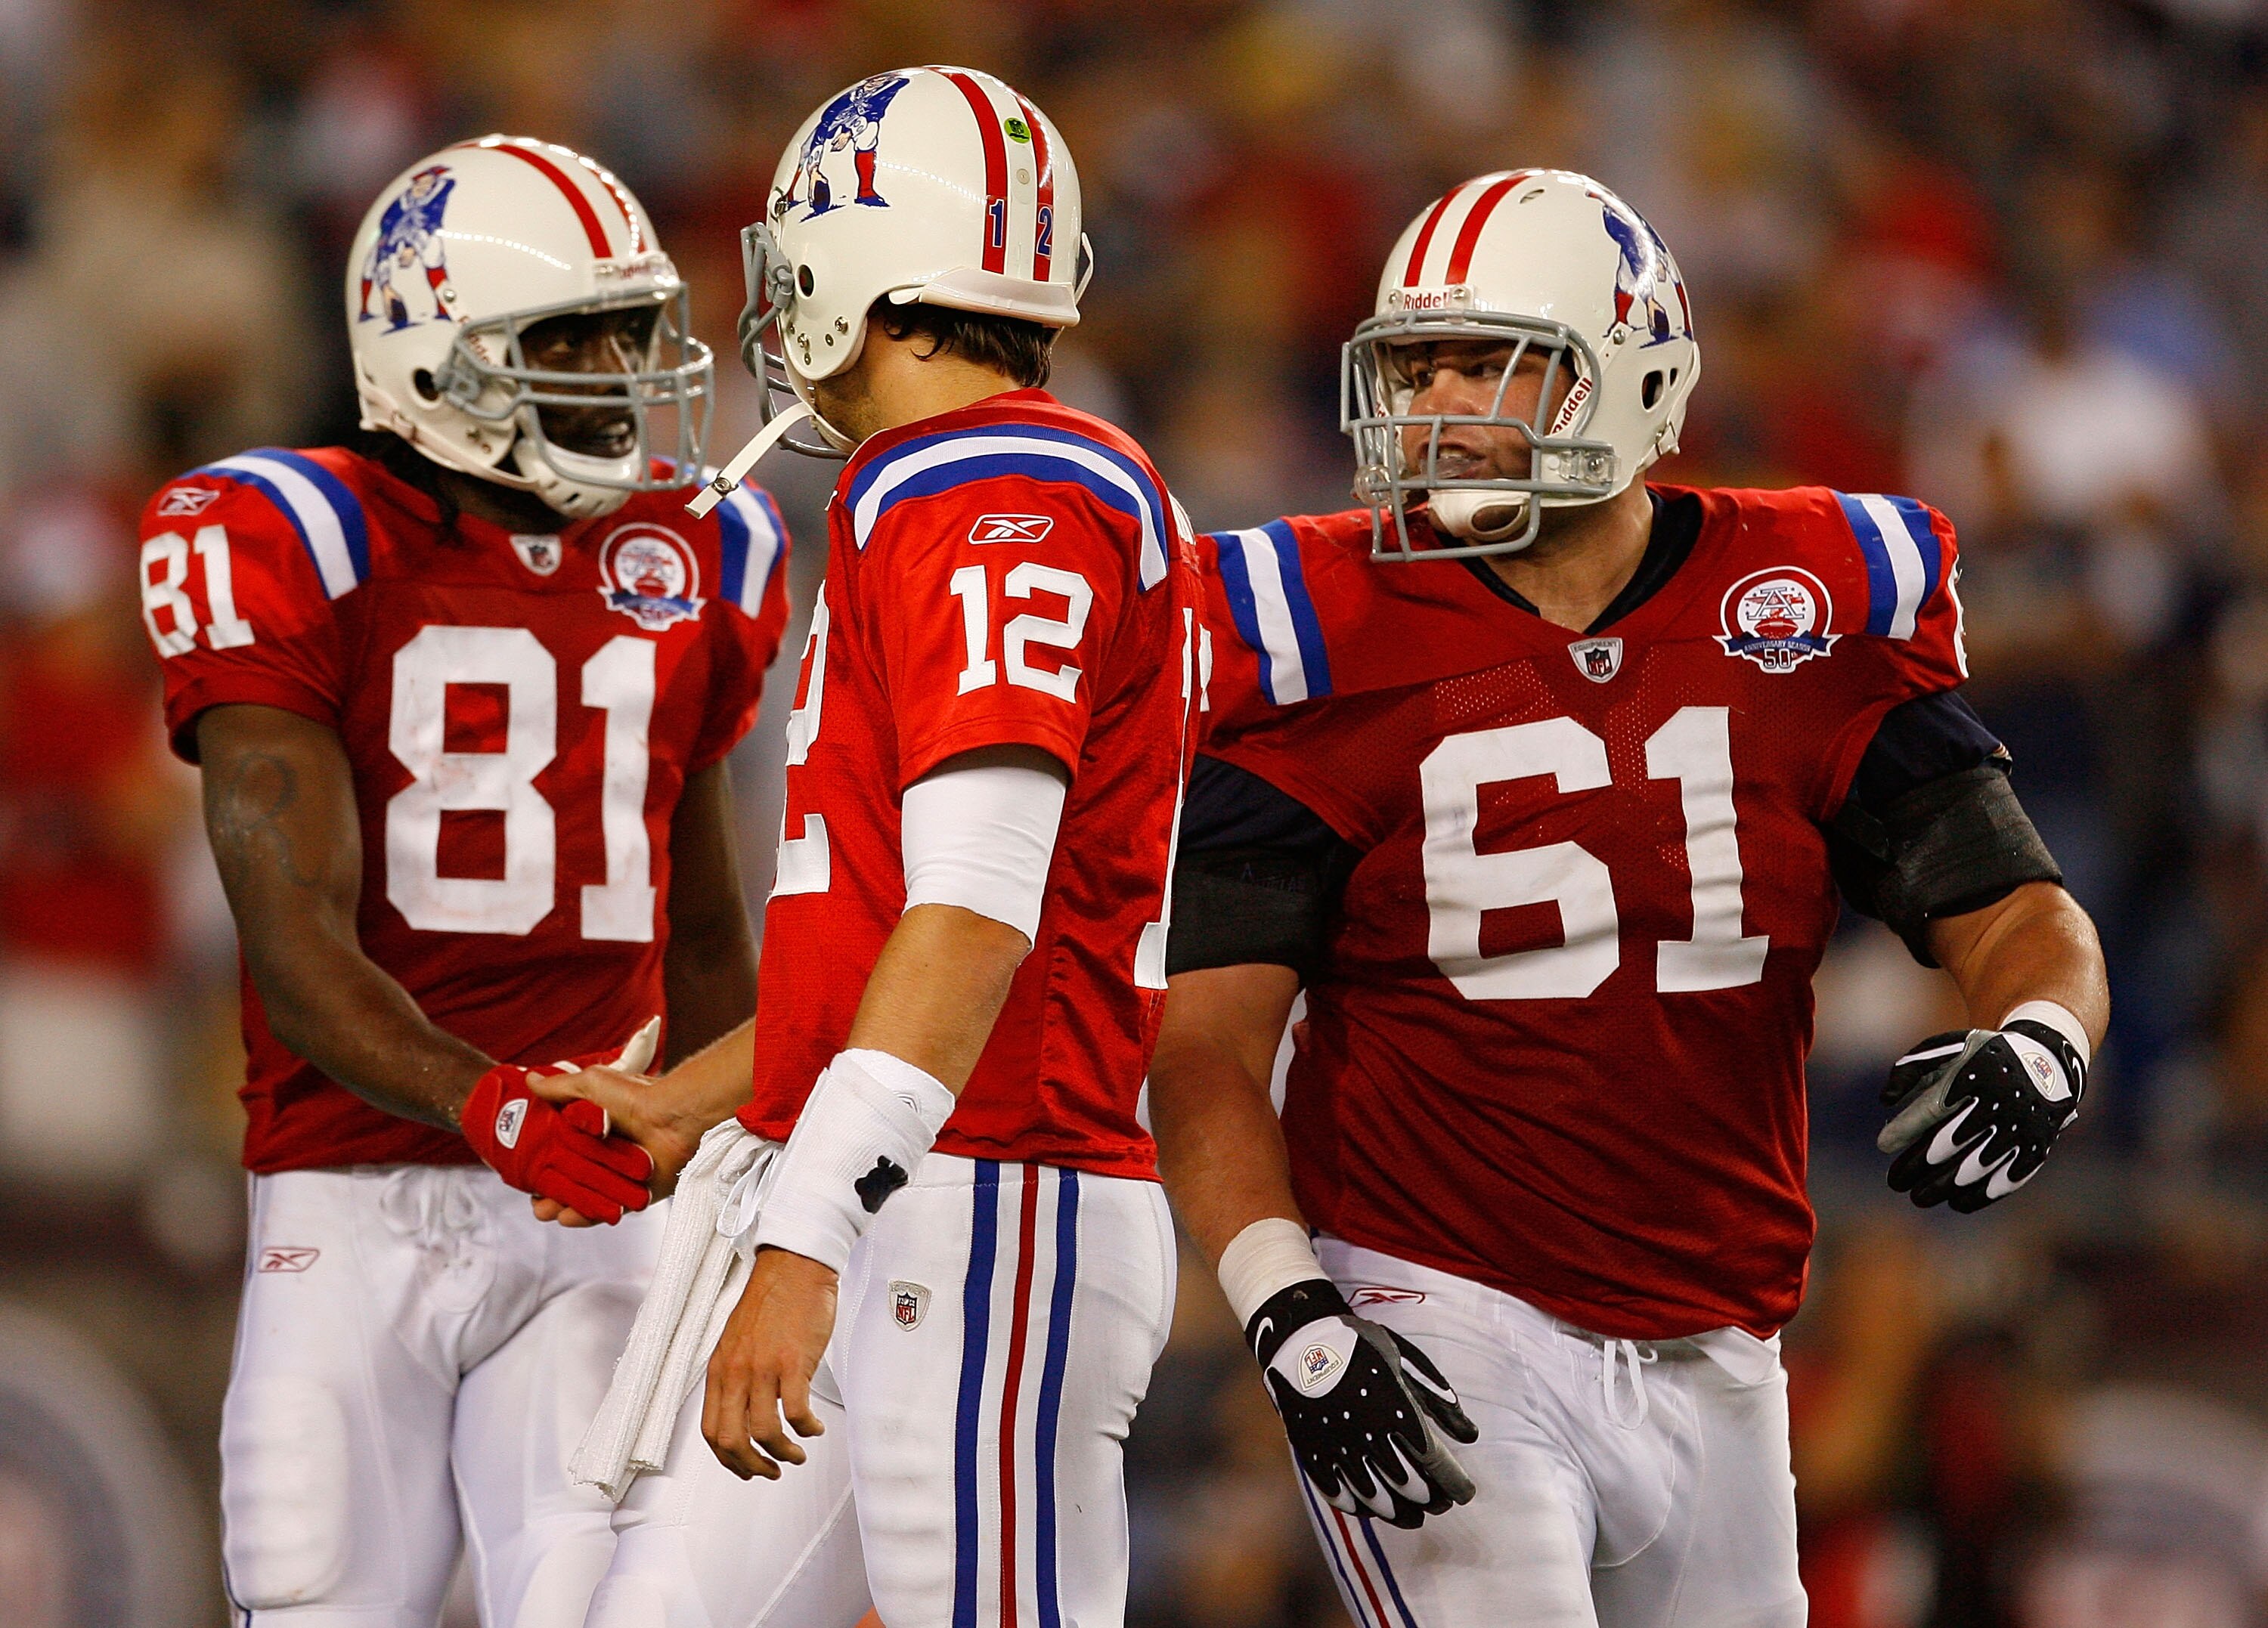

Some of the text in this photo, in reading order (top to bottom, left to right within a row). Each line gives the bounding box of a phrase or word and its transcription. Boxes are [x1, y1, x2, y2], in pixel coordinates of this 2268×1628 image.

[989, 198, 1052, 257] 1 2
[1403, 292, 1447, 310] Riddel
[140, 525, 256, 658] 81
[950, 562, 1094, 704] 12
[385, 625, 657, 943] 81
[1419, 706, 1770, 1001] 61
[897, 1305, 916, 1322] NFL
[1306, 1350, 1324, 1365] NFL
[1307, 1360, 1339, 1384] EQUIPMENT
